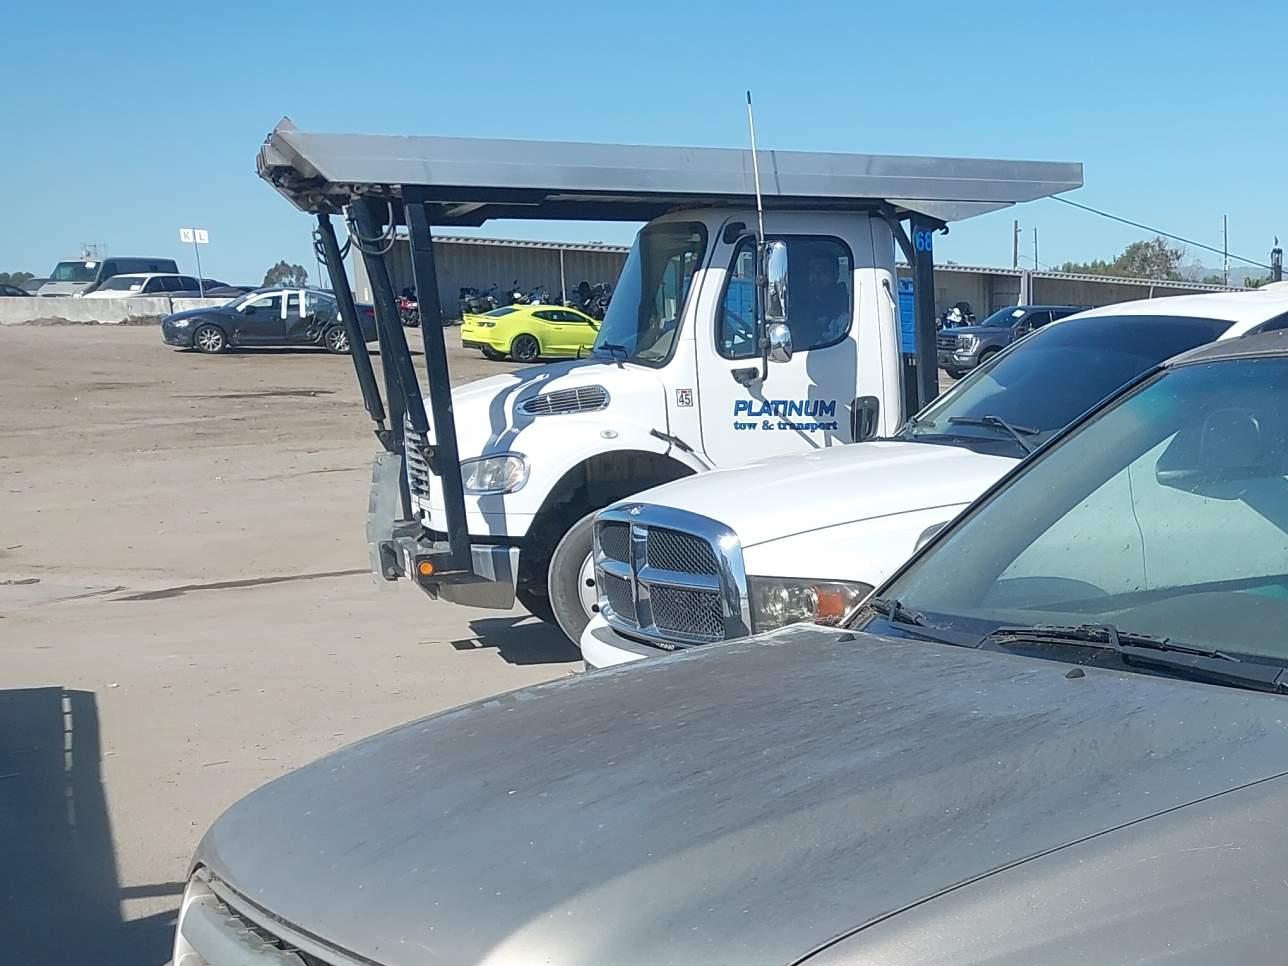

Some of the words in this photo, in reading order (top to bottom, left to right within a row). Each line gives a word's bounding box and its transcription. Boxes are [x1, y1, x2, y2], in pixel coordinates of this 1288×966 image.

[916, 231, 932, 251] 68
[679, 393, 691, 405] 45
[733, 400, 836, 417] PLATINUM
[733, 421, 758, 431] tow
[761, 420, 775, 431] &
[777, 421, 838, 433] transport
